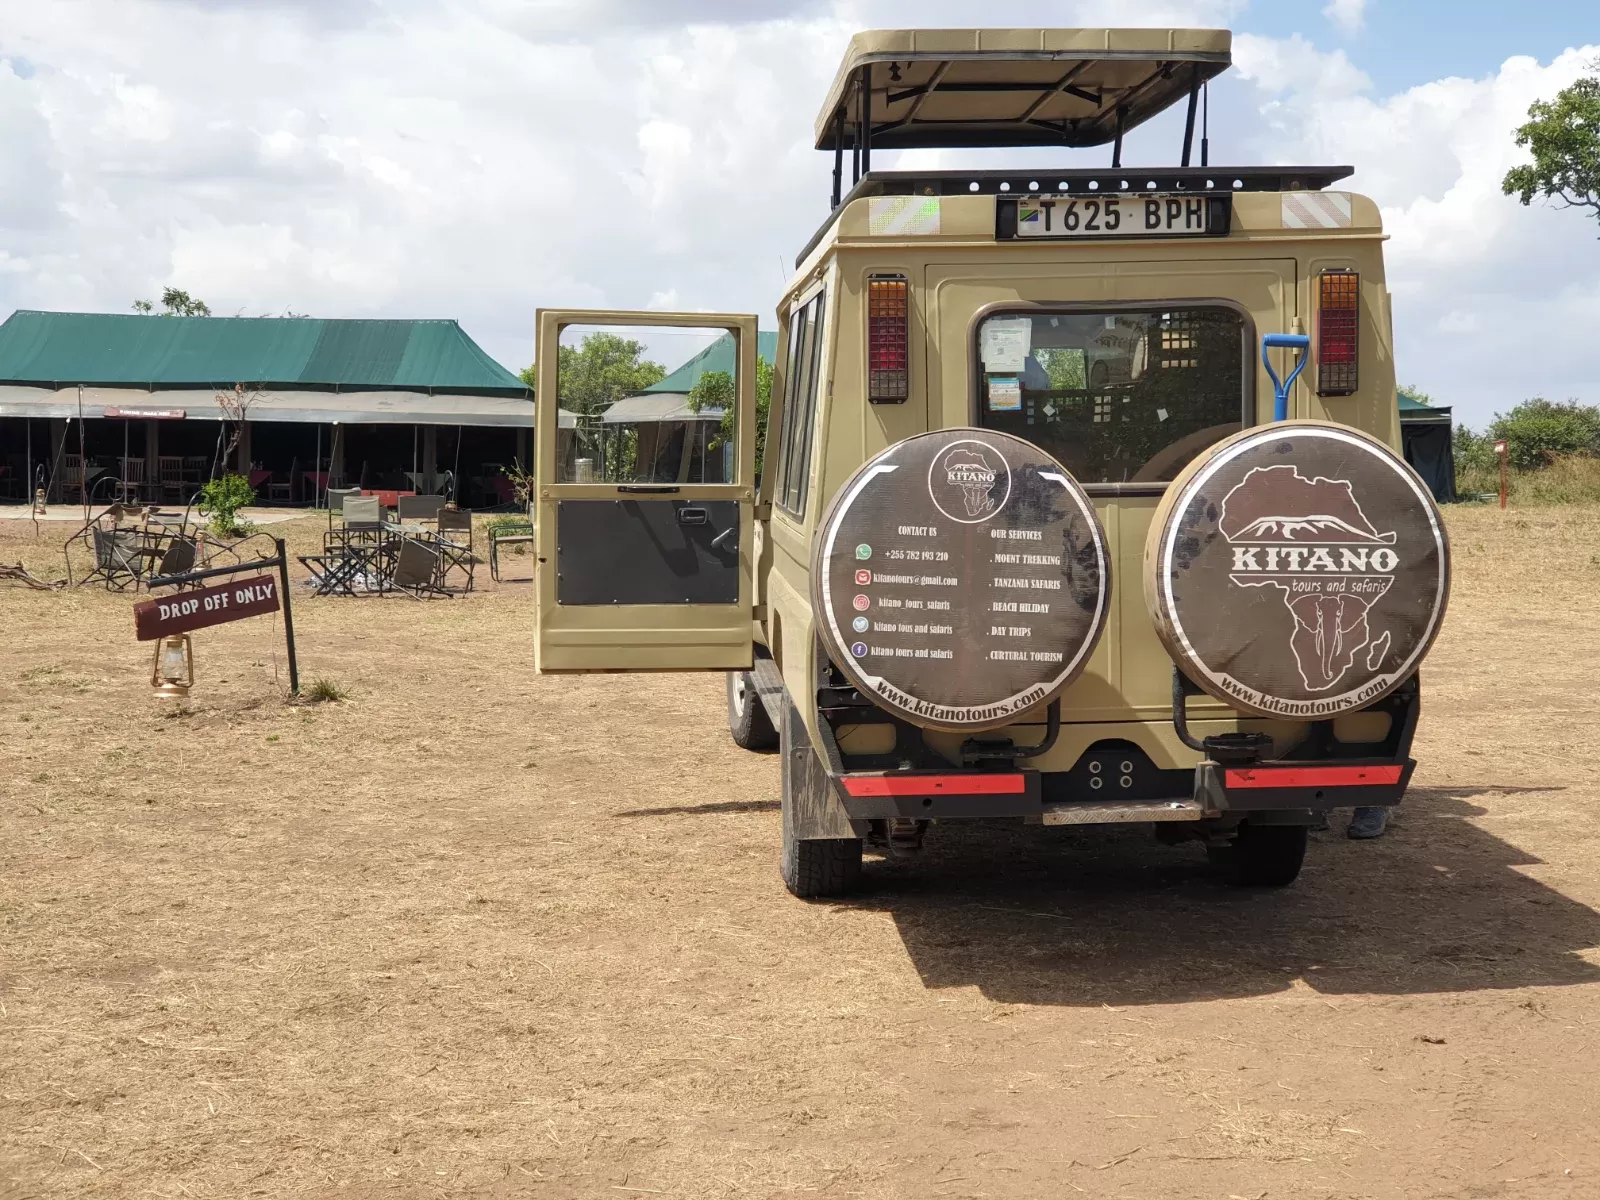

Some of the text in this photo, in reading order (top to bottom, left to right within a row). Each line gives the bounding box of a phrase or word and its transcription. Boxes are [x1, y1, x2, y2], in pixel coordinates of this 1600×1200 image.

[1040, 199, 1202, 231] T 625 BPH
[947, 471, 996, 482] KITANO
[898, 525, 937, 537] CONTACT US
[990, 529, 1042, 541] OUR SERVICES
[885, 549, 949, 562] +255 782 193 210
[994, 553, 1061, 566] MOUNT TREKKING
[1231, 546, 1400, 573] KITANO
[873, 572, 958, 586] kitanotours@gmail.com
[993, 577, 1061, 590] TANZANIA SAFARIS
[1292, 577, 1387, 594] tours and safaris
[158, 583, 273, 621] DROP OFF ONLY
[878, 597, 951, 611] kitano_tours_safaris
[992, 602, 1050, 614] BEACH HILIDAY
[873, 621, 953, 635] kitano tous and safaris
[991, 626, 1032, 637] DAY TRIPS
[870, 646, 954, 660] kitano tours and safaris
[1029, 651, 1064, 663] TOURISM
[876, 681, 1047, 722] www.kitanotours.com
[1220, 676, 1389, 716] www.kitanotours.com
